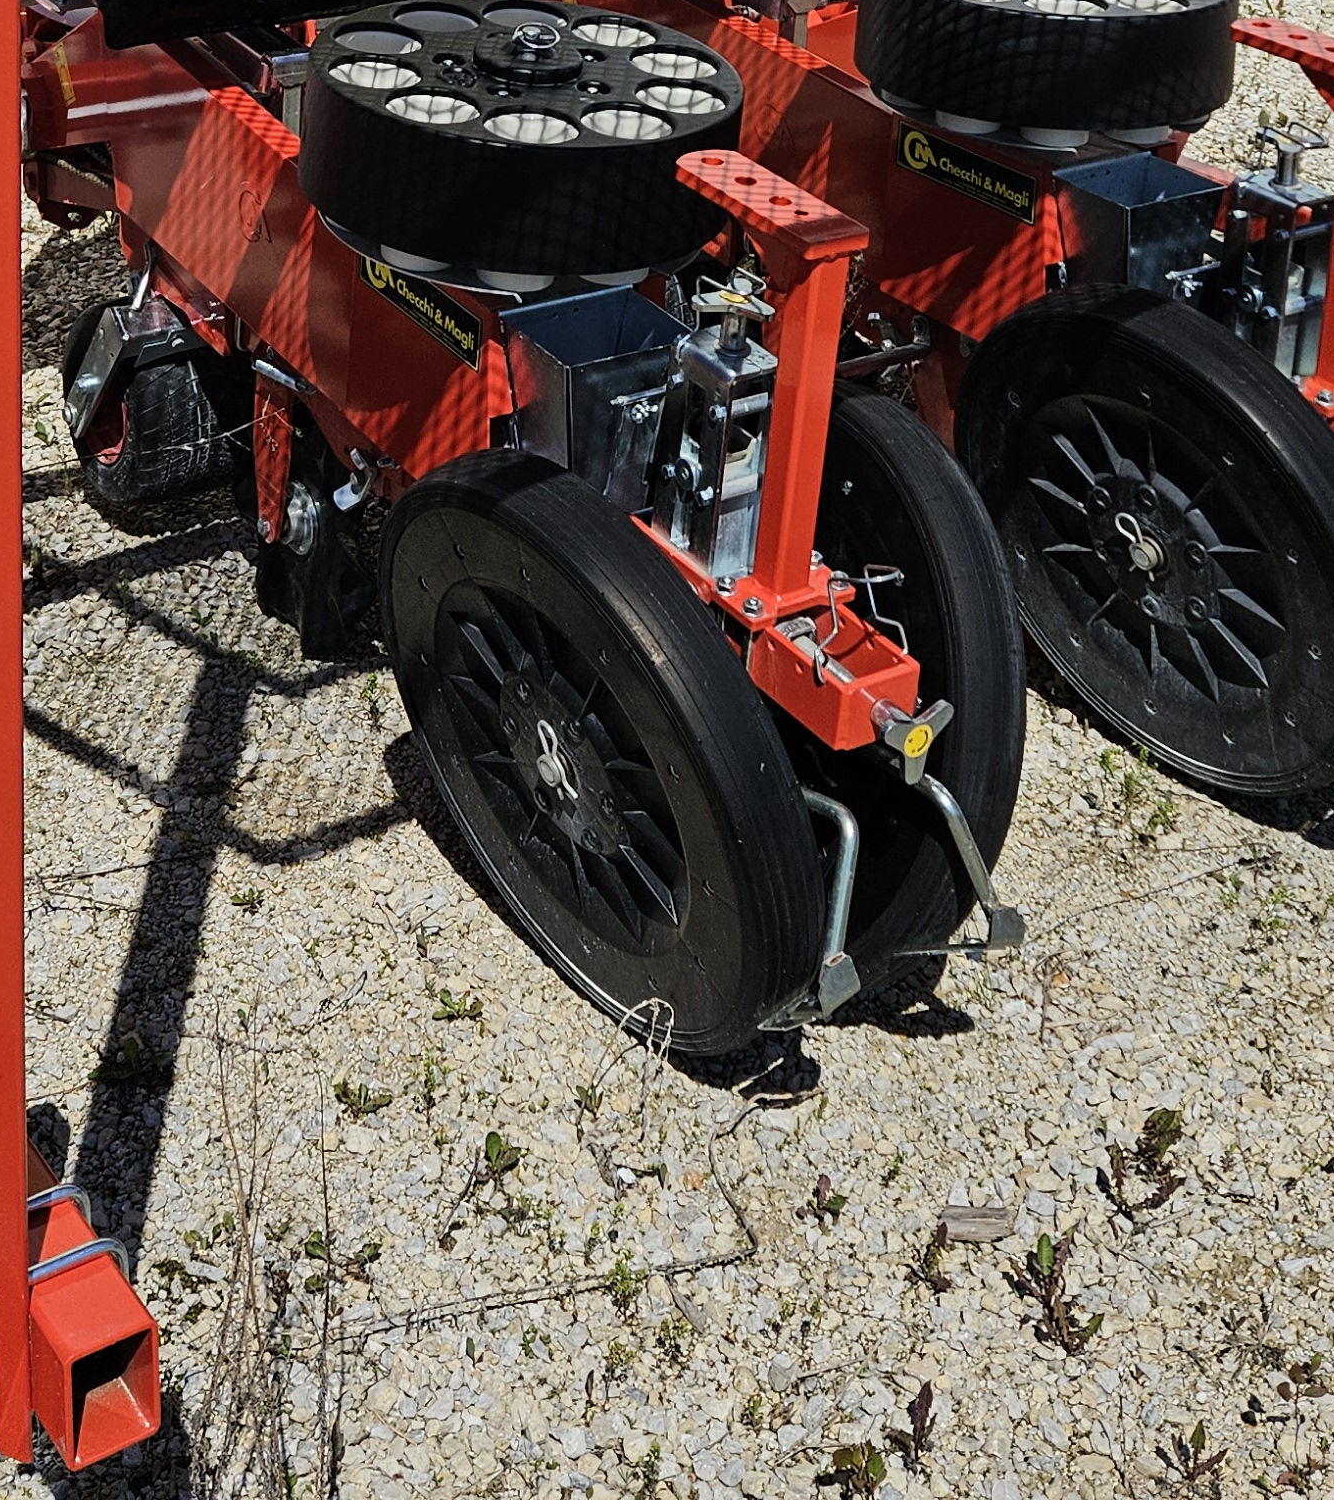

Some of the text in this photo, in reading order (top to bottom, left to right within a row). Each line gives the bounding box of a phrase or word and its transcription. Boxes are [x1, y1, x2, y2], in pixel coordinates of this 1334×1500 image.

[939, 156, 982, 187] Checchi
[983, 177, 993, 191] &
[994, 180, 1030, 208] Magli
[396, 277, 434, 319] Checchi
[434, 309, 444, 325] &
[444, 315, 475, 351] Magli
